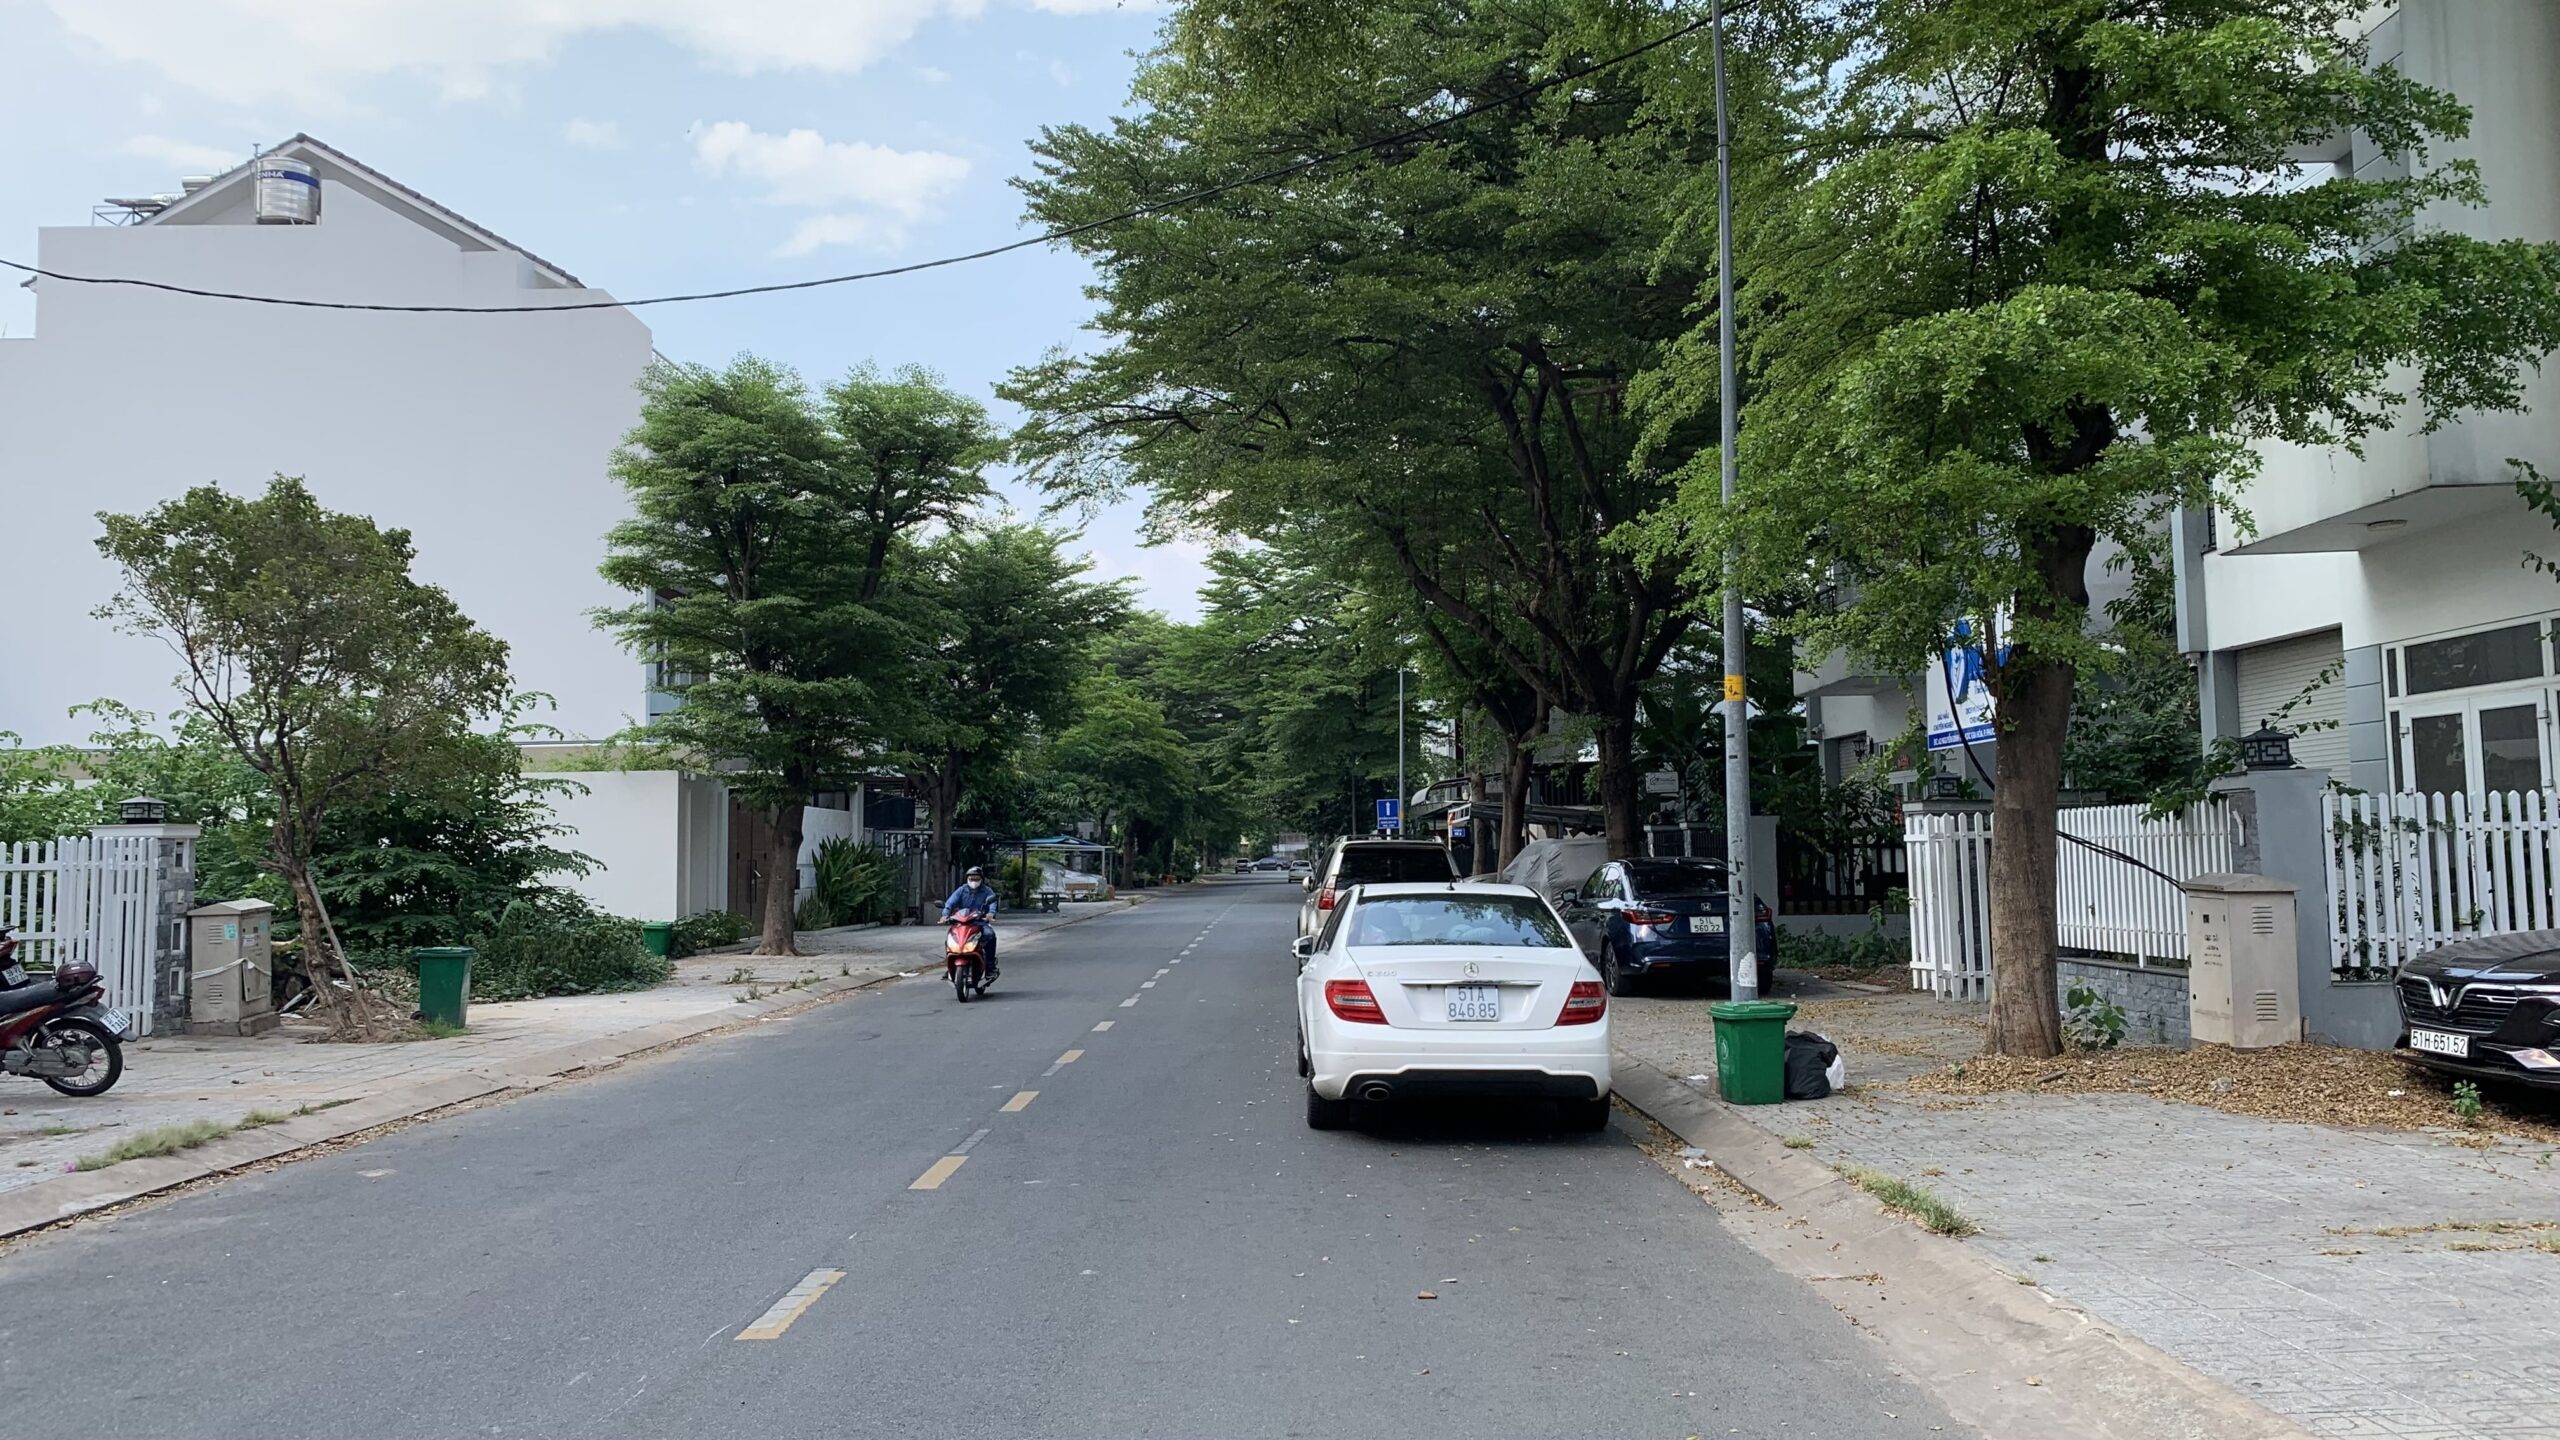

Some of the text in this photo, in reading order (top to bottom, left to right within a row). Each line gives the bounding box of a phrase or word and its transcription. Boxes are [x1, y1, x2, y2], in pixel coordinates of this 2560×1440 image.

[1458, 986, 1485, 1001] 51A
[1448, 1002, 1497, 1018] 846.85
[2412, 1030, 2466, 1054] 51H-651.52
